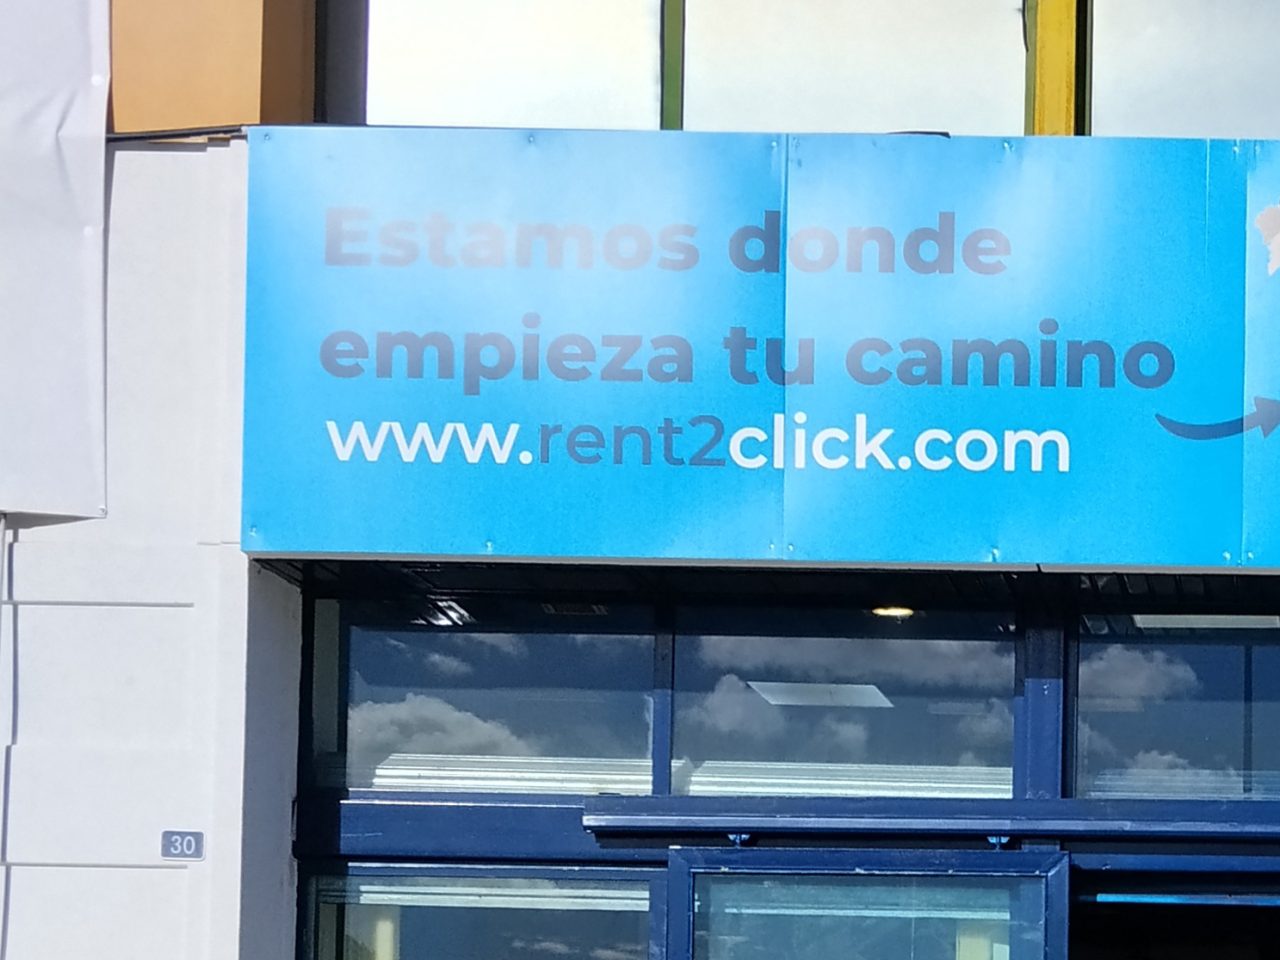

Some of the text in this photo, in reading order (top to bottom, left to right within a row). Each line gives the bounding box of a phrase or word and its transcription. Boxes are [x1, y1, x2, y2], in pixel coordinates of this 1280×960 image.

[324, 204, 1012, 277] Estamos donde
[320, 313, 1176, 396] empieza tu camino
[325, 413, 1070, 473] www.rent2click.com
[170, 835, 195, 854] 30
